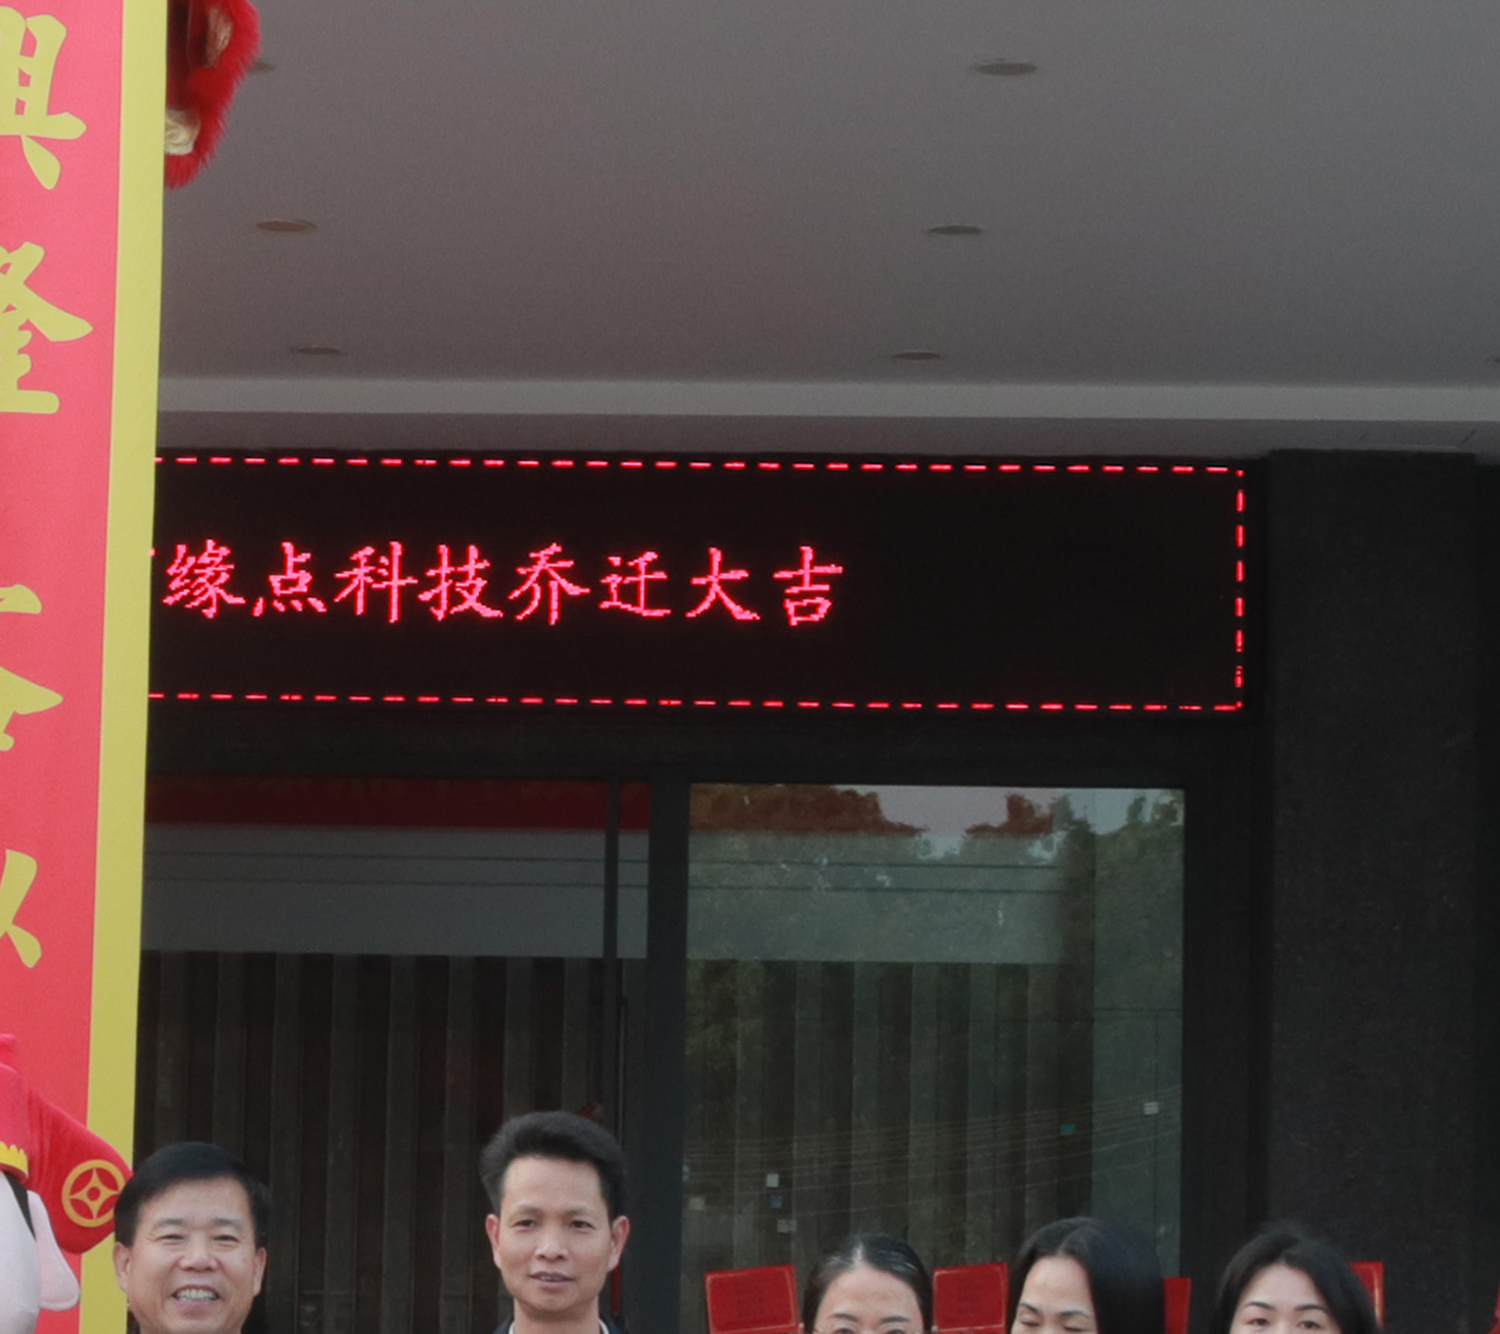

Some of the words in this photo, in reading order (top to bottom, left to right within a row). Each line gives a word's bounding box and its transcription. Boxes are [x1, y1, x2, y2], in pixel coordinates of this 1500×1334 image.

[149, 540, 844, 625] 缘点科技乔迁大吉
